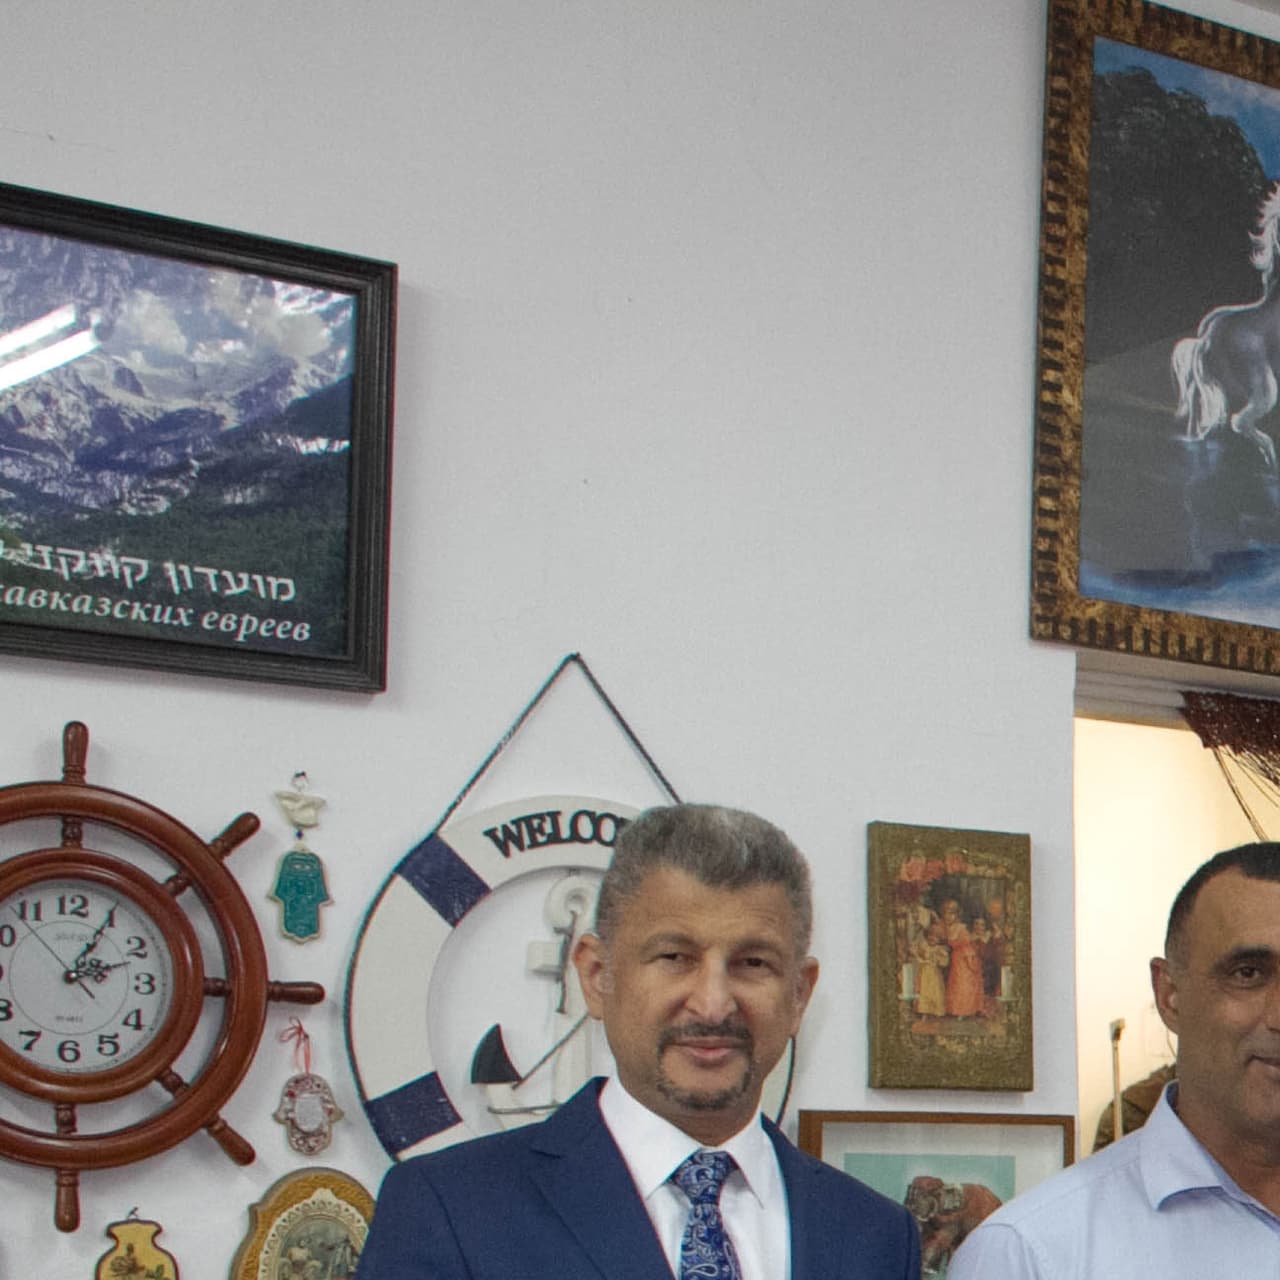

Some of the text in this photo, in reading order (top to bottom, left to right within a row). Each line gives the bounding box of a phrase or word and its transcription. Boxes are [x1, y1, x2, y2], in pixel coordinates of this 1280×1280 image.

[163, 561, 297, 602] מועדון
[0, 584, 311, 642] авказских евреев
[482, 809, 631, 858] WELCO
[18, 900, 43, 921] 11
[57, 894, 90, 918] 12
[126, 936, 149, 960] 2
[134, 972, 156, 996] 3
[122, 1008, 144, 1032] 4
[18, 1029, 42, 1052] 7
[57, 1039, 81, 1064] 6
[97, 1032, 120, 1057] 5
